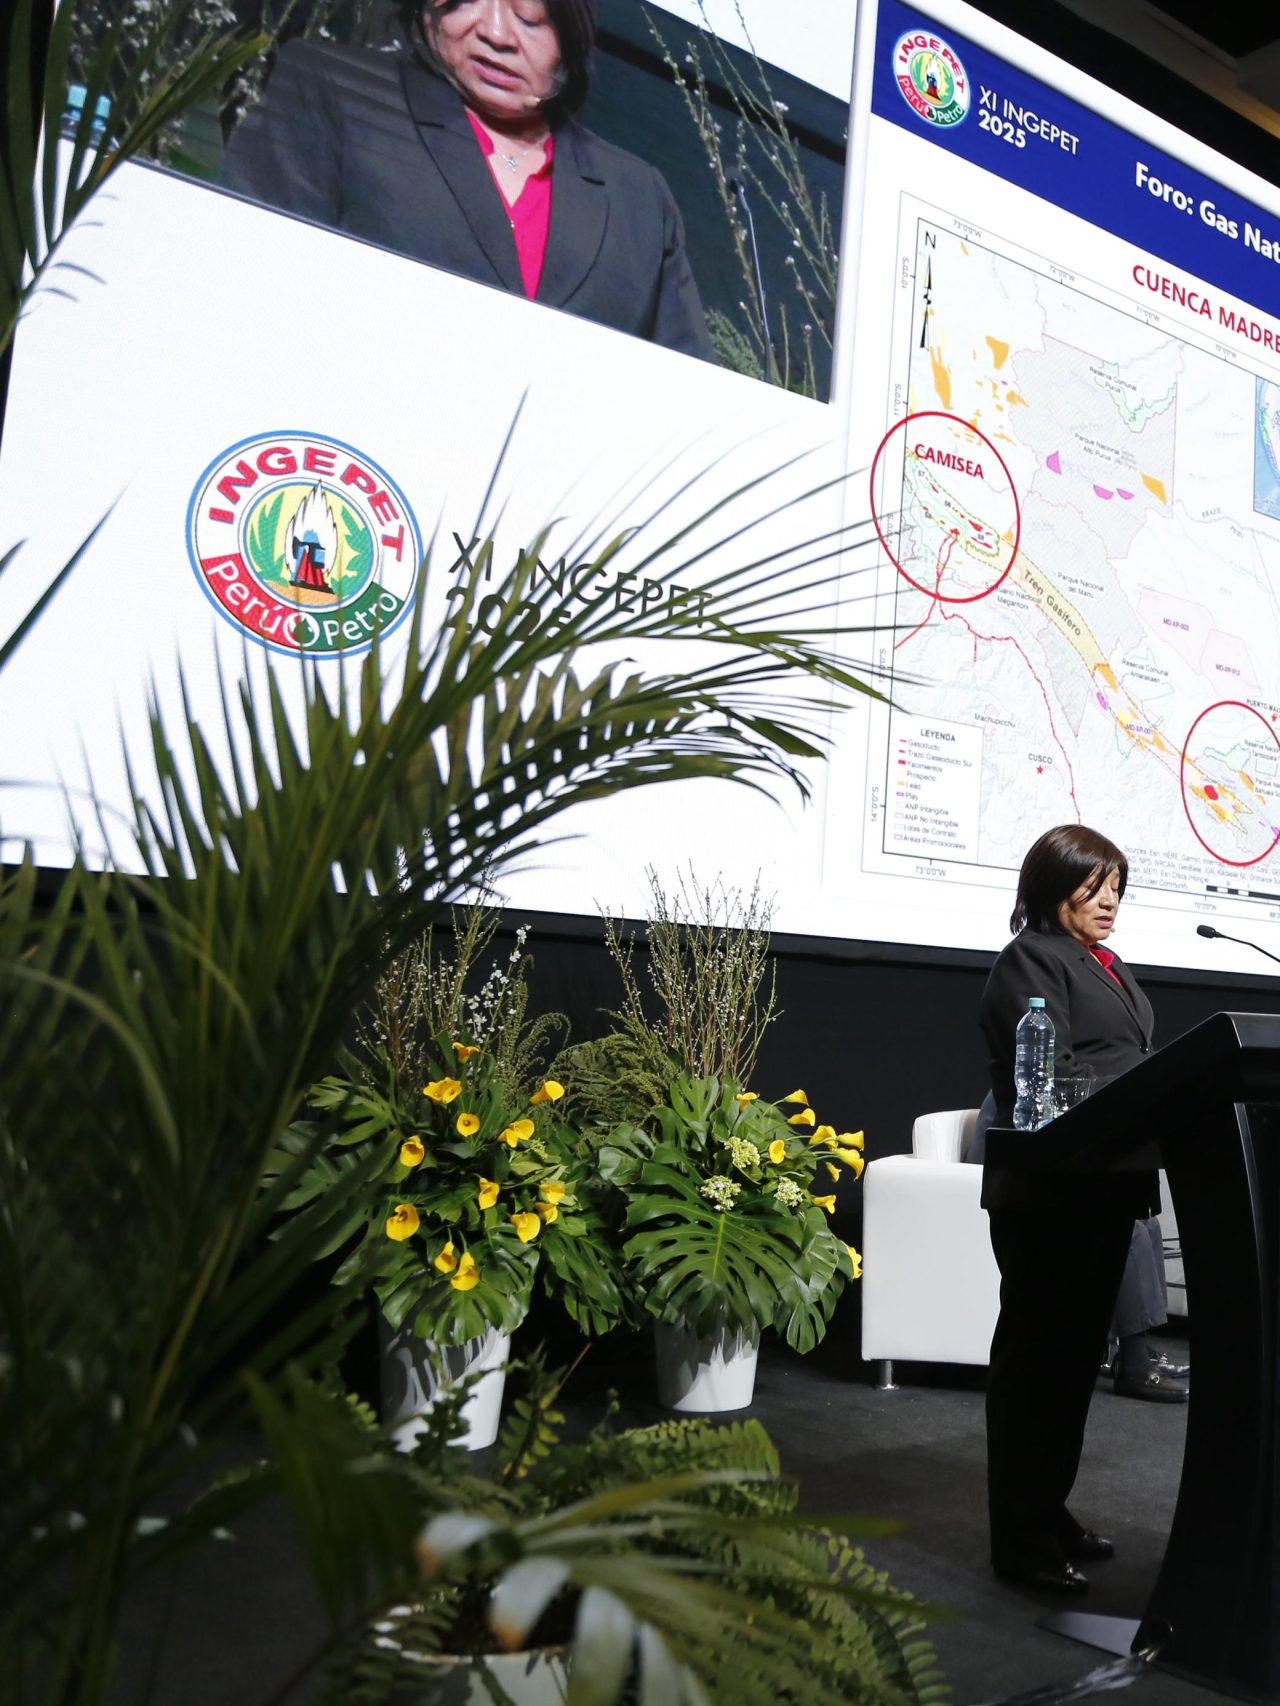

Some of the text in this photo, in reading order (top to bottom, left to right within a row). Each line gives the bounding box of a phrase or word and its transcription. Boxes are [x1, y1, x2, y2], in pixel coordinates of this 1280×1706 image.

[898, 35, 965, 93] INGEPET
[978, 84, 1079, 155] XI INGEPET
[978, 108, 1027, 149] 2025
[1135, 161, 1194, 215] Foro:
[1199, 200, 1239, 240] Gas
[924, 230, 937, 250] N
[1132, 264, 1213, 320] CUENCA
[914, 443, 985, 480] CAMISEA
[208, 446, 405, 563] INGEPET
[448, 531, 494, 582] XI
[206, 559, 399, 647] Perú Petro
[1023, 569, 1045, 596] Tren
[920, 728, 956, 742] LEYENDA
[1027, 752, 1053, 765] CUSCO
